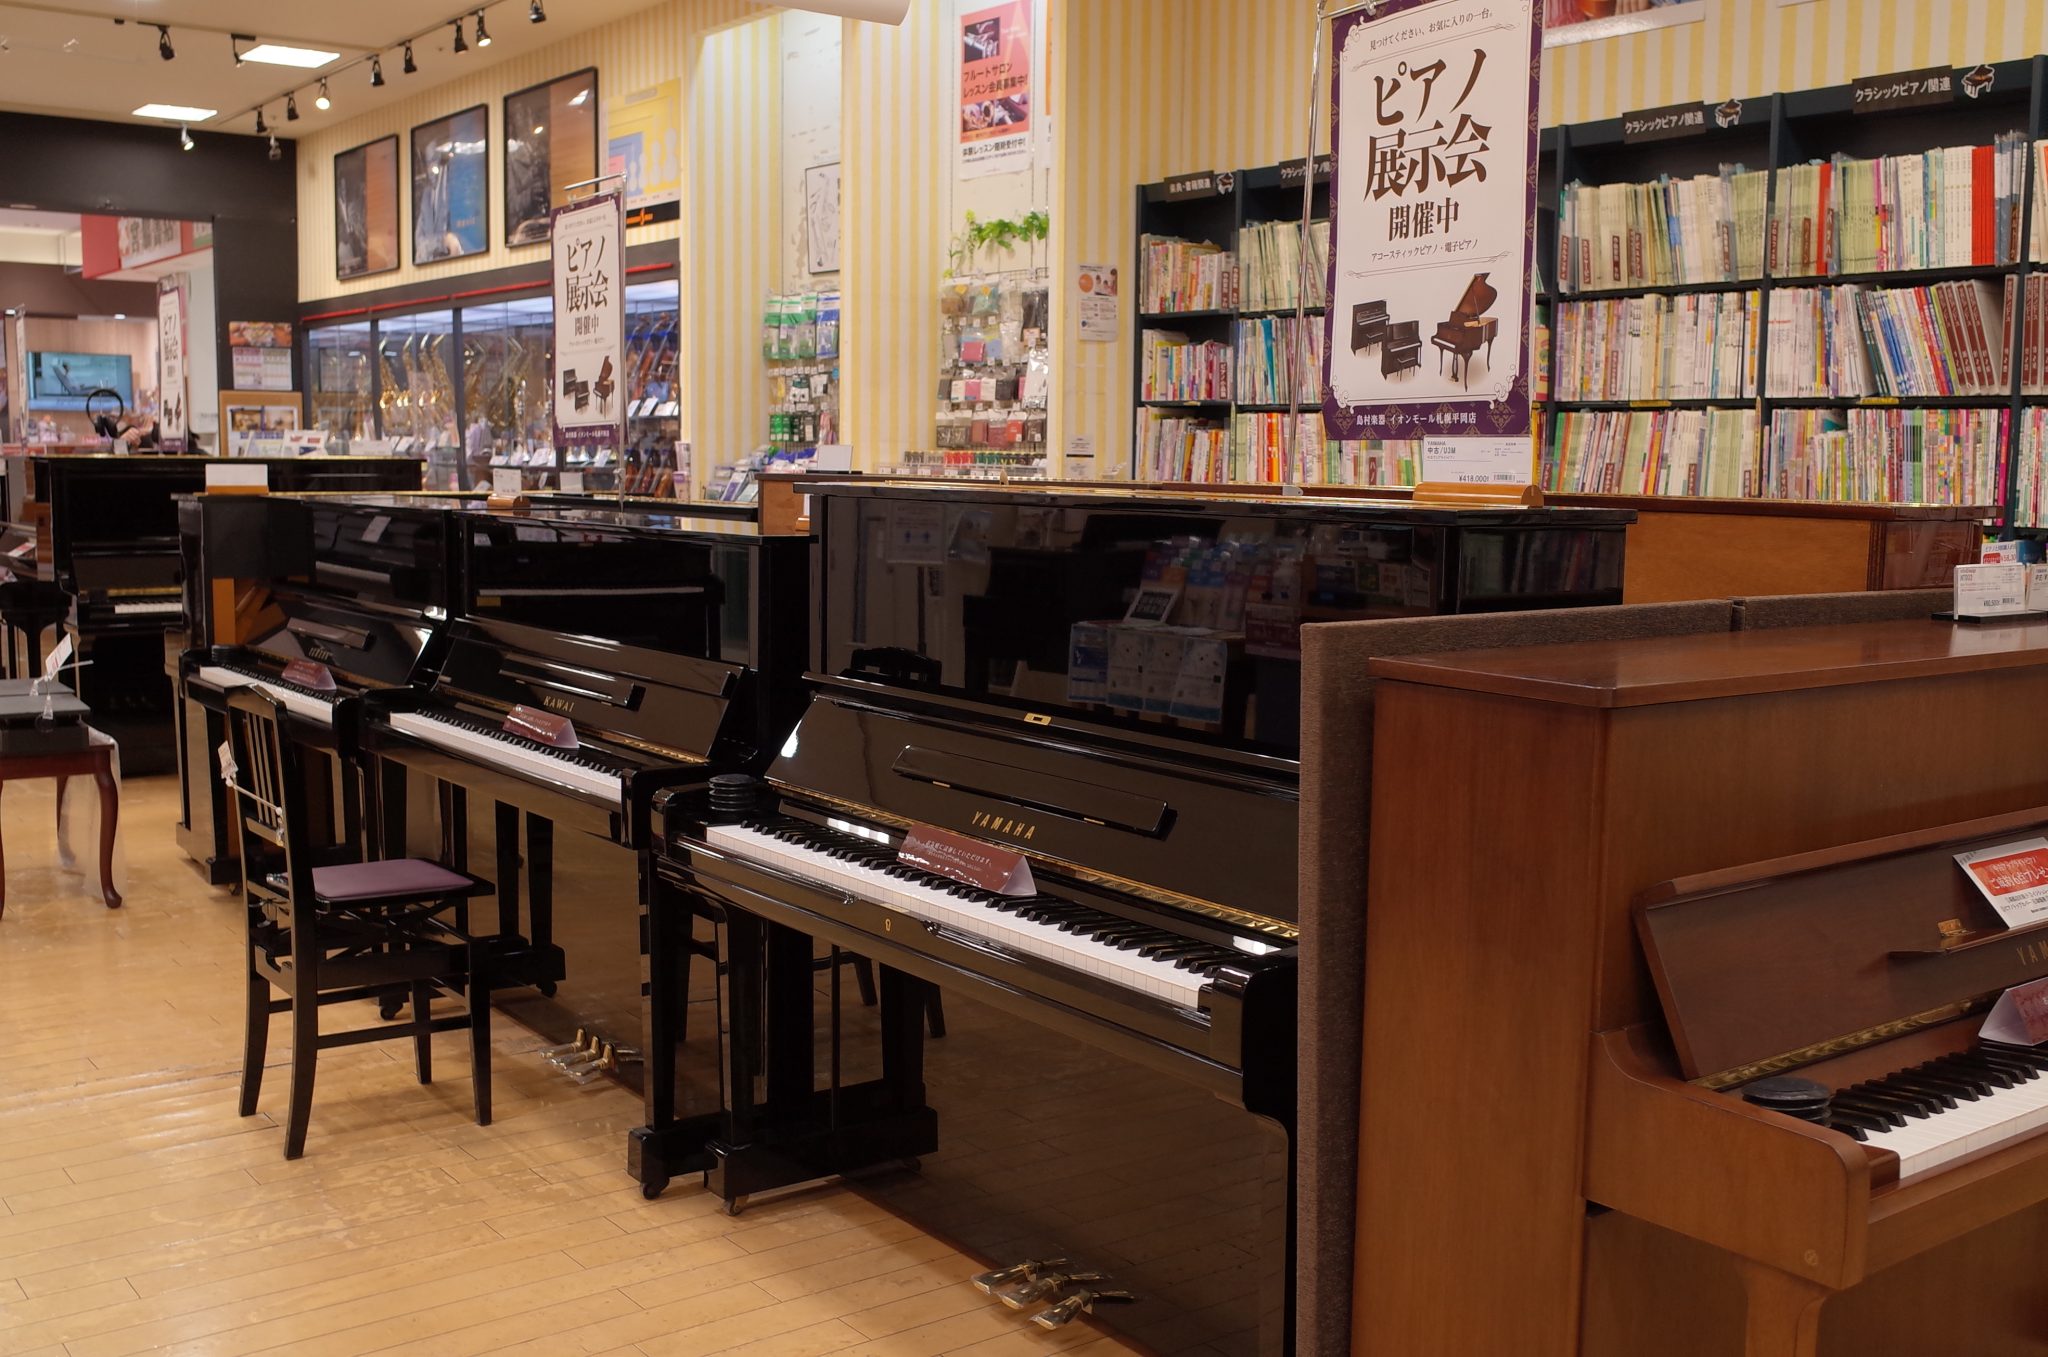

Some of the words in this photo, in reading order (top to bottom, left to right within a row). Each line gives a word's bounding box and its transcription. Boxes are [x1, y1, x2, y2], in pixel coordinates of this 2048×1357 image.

[1369, 8, 1493, 51] 見つけてください、お気に入りの一台。
[963, 63, 1013, 83] フルートサロン
[1373, 49, 1487, 126] ピアノ
[1855, 76, 1952, 104] クラシックピアノ関連
[1625, 110, 1705, 135] クラシックピアノ関連
[1363, 113, 1493, 202] 展示会
[1388, 197, 1460, 242] 開催中
[567, 235, 606, 272] ピアノ
[1371, 238, 1479, 263] アコースティックピアノ・電子ピアノ
[565, 270, 609, 313] 展示会
[1356, 413, 1386, 426] 島村楽器
[1389, 411, 1477, 425] イオンモール札幌平岡店
[543, 696, 575, 713] KAWAI
[971, 810, 1036, 840] YAMAHA
